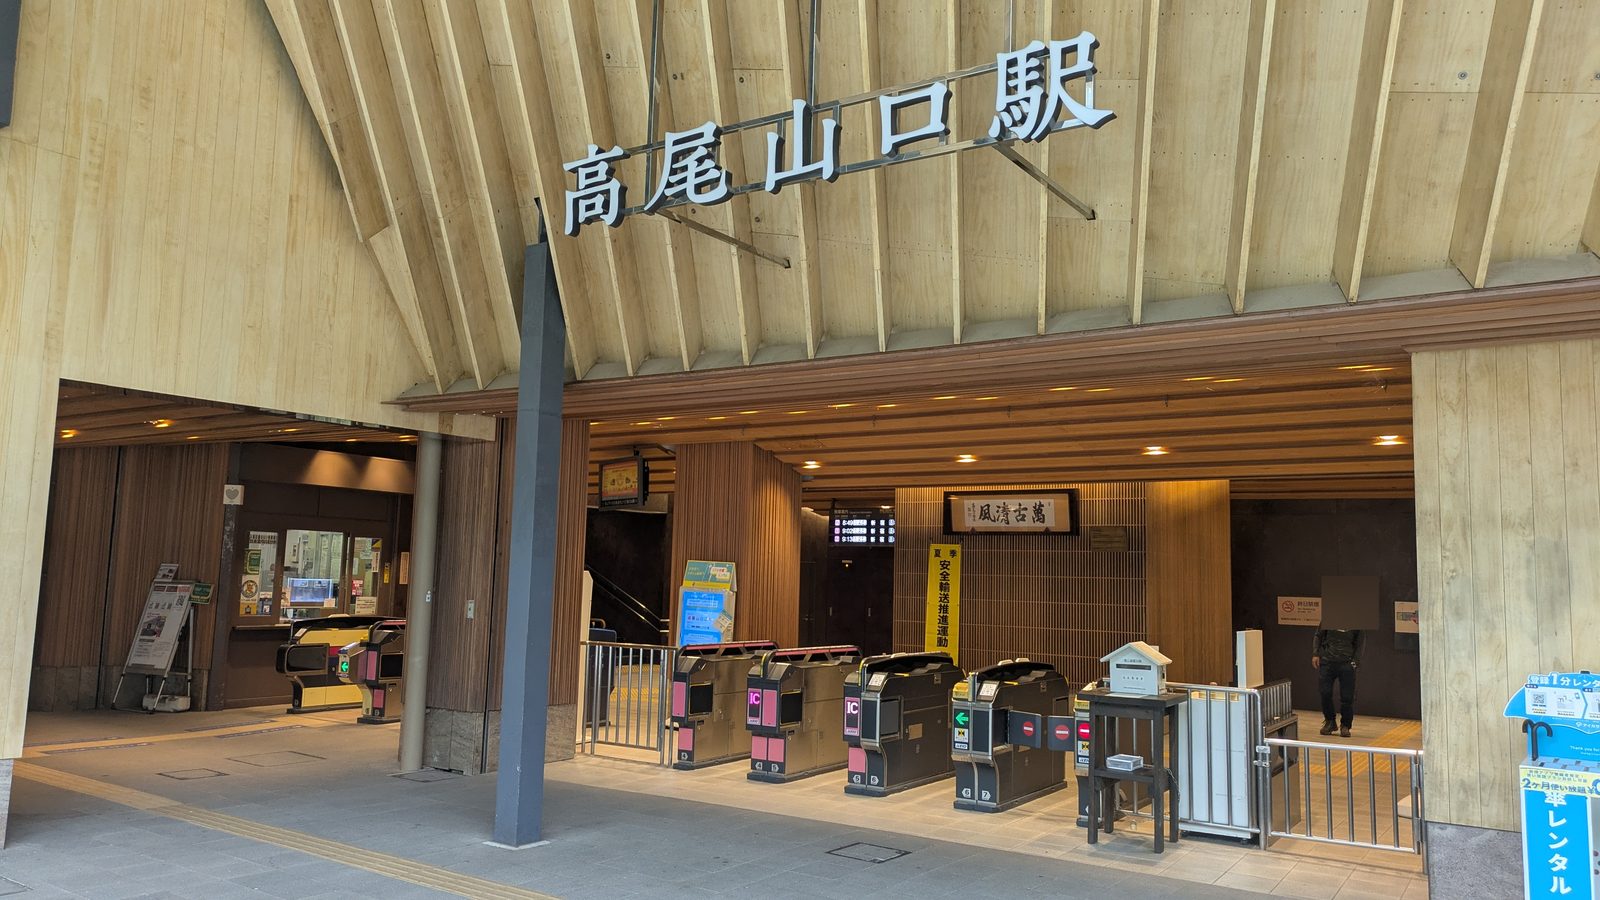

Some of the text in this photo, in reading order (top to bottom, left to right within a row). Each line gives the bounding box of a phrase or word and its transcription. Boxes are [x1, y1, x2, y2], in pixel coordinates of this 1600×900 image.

[562, 30, 1116, 237] 高尾山口駅
[936, 559, 951, 648] 安全輸送推進運動
[749, 692, 761, 705] IC
[846, 701, 859, 714] IC
